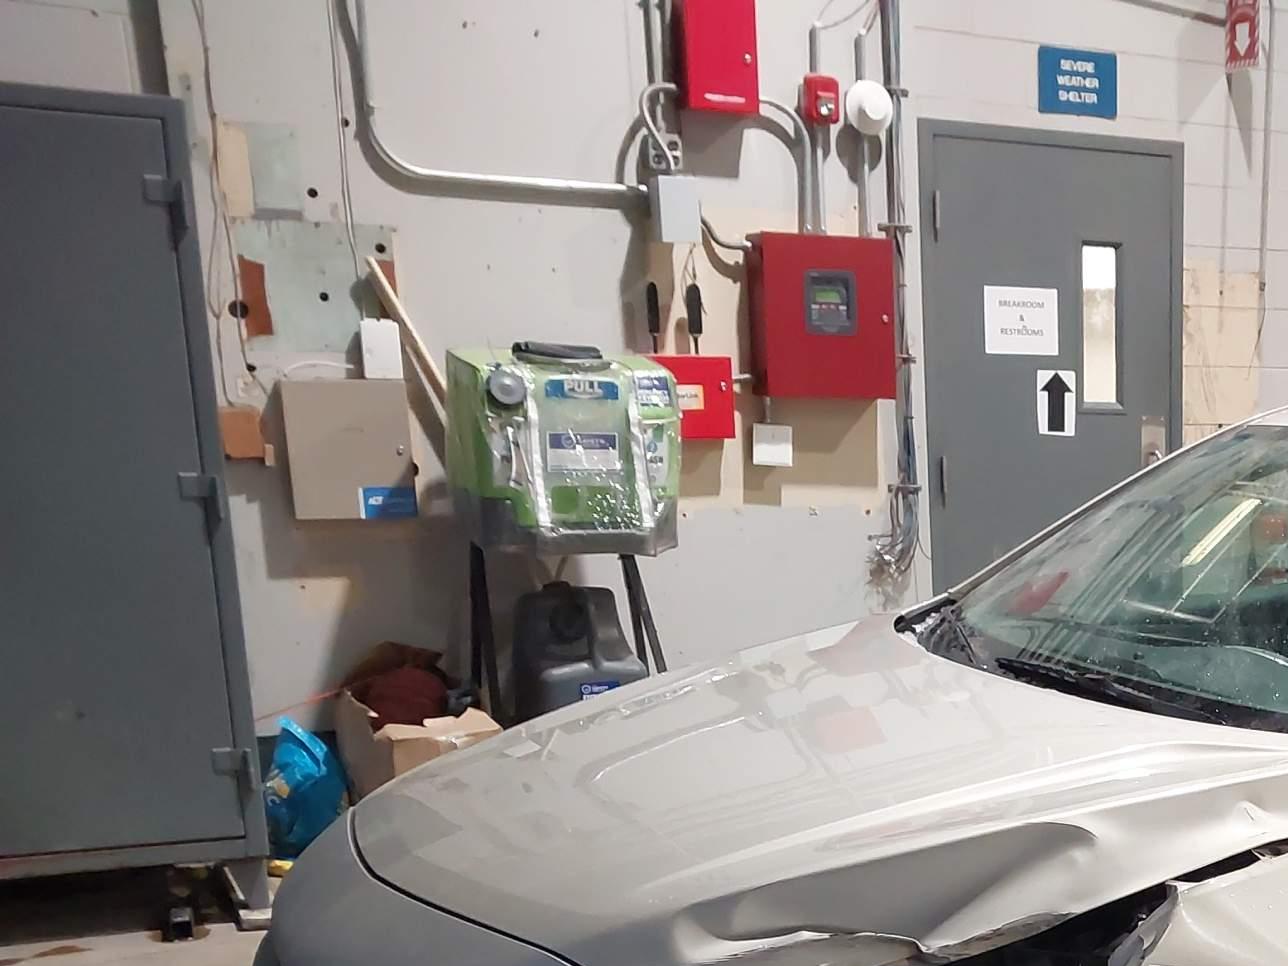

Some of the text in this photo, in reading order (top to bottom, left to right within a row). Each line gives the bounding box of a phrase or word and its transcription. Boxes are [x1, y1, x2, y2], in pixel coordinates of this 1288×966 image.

[1060, 58, 1095, 73] SEVERE
[1056, 73, 1100, 90] WEATHER
[1058, 90, 1098, 104] SHELTER
[998, 299, 1045, 309] BREAKROOM
[1019, 313, 1025, 322] &
[1000, 327, 1044, 337] RESTROOMS
[564, 379, 602, 393] PULL
